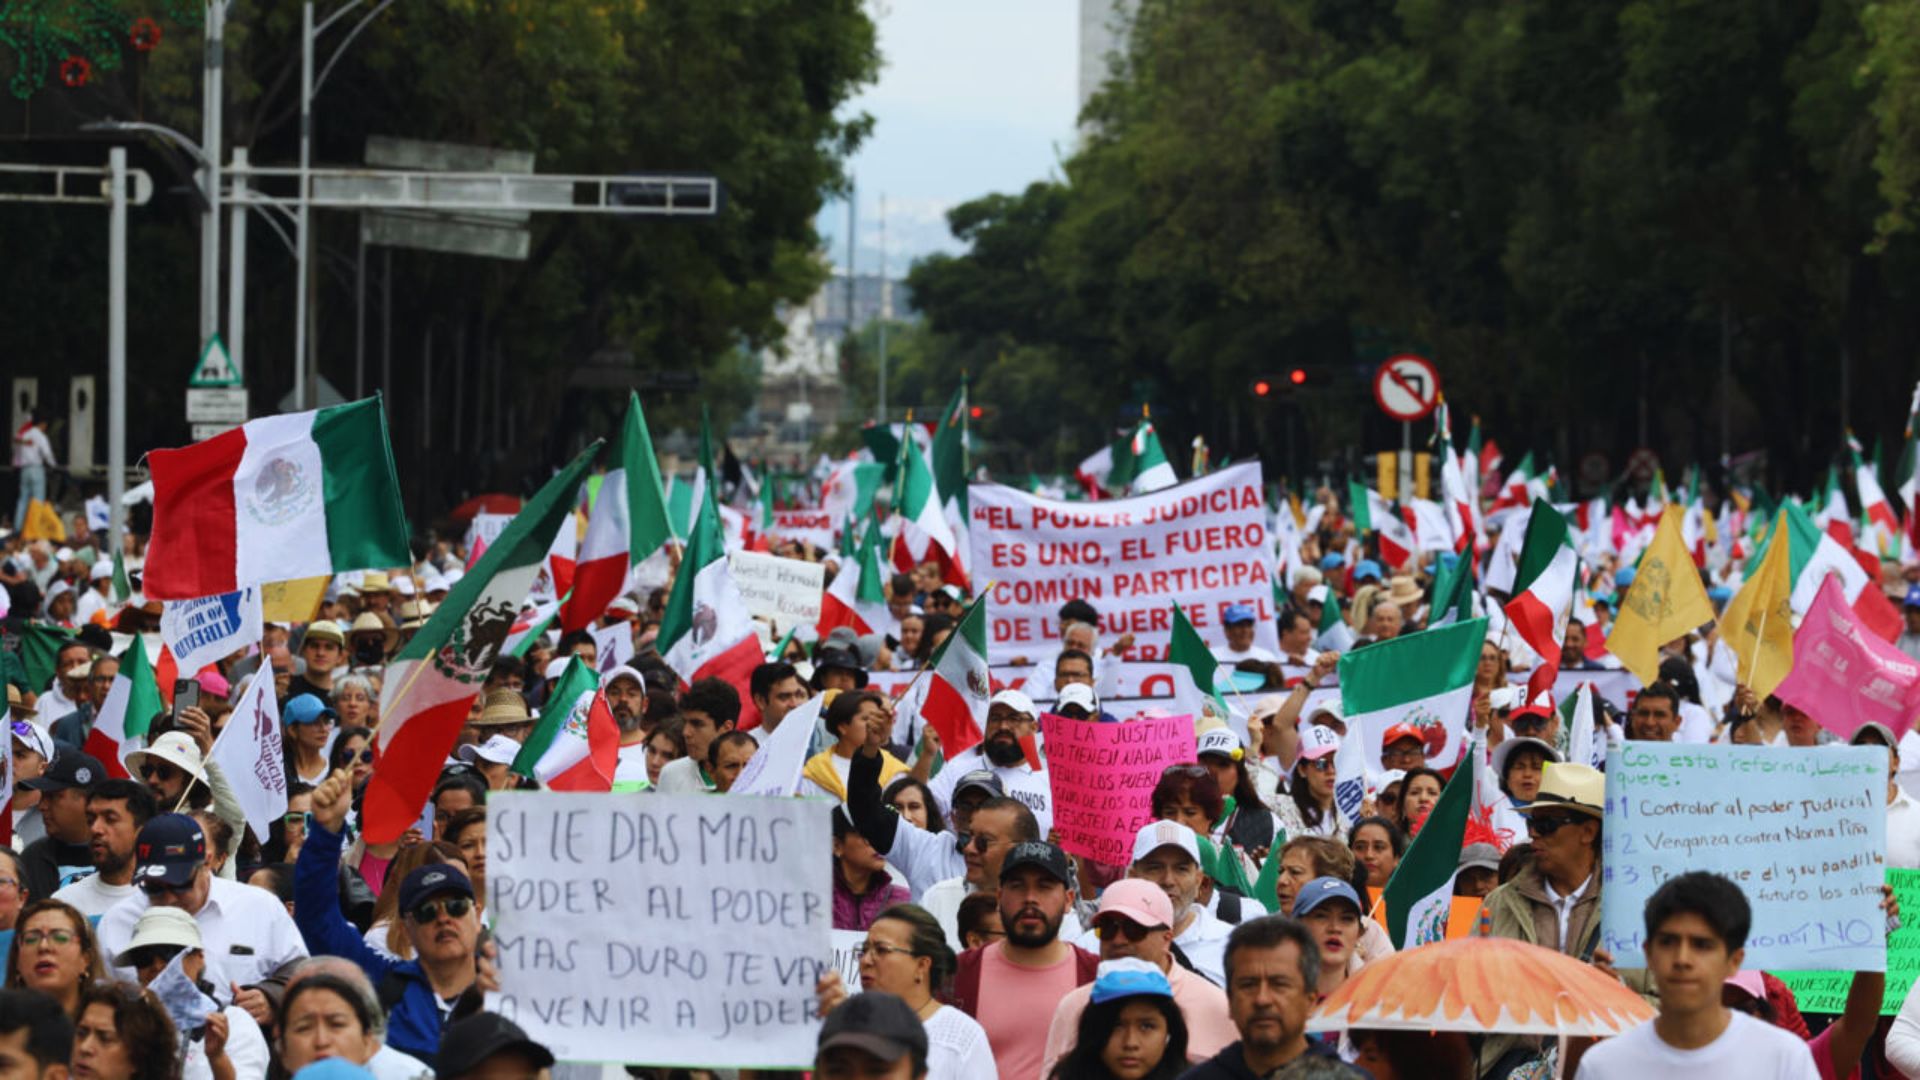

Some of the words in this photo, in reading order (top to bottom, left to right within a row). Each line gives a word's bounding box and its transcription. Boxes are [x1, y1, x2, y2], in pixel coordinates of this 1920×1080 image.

[1032, 506, 1132, 528] PODER
[1142, 485, 1264, 524] JUDICIA
[991, 543, 1027, 567] ES
[1038, 541, 1110, 566] UNO,
[1120, 538, 1154, 561] EL
[1165, 522, 1264, 554] FUERO
[993, 573, 1102, 604] COMÚN
[1114, 561, 1268, 597] PARTICIPA
[993, 617, 1031, 642] DE
[1073, 724, 1096, 744] LA
[1205, 735, 1231, 748] PJF
[1068, 744, 1120, 767] TIENEN
[1122, 749, 1163, 765] NADA
[1168, 742, 1188, 760] QUE
[1670, 753, 1718, 769] esta
[1089, 771, 1115, 790] LOS
[1119, 771, 1157, 789] PUEBL
[1011, 789, 1045, 812] SOMOS
[1640, 799, 1720, 817] Controlar
[1725, 797, 1743, 816] al
[1749, 801, 1794, 820] poder
[1114, 817, 1126, 832] A
[495, 810, 527, 862] SI
[609, 811, 681, 866] DAS
[699, 812, 793, 865] MAS
[1644, 831, 1730, 858] Venganza
[1735, 832, 1781, 845] contra
[1785, 825, 1834, 840] Norma
[1838, 817, 1868, 836] Piña
[1786, 865, 1796, 885] y
[1800, 864, 1816, 875] su
[493, 876, 616, 915] PODER
[648, 884, 692, 921] AL
[712, 886, 823, 929] PODER
[1758, 887, 1808, 901] futuro
[1819, 884, 1842, 901] los
[1815, 918, 1873, 948] NO
[494, 936, 579, 973] MAS
[607, 941, 708, 981] DURO
[725, 951, 763, 987] TE
[532, 993, 652, 1031] VENIR
[677, 999, 696, 1028] A
